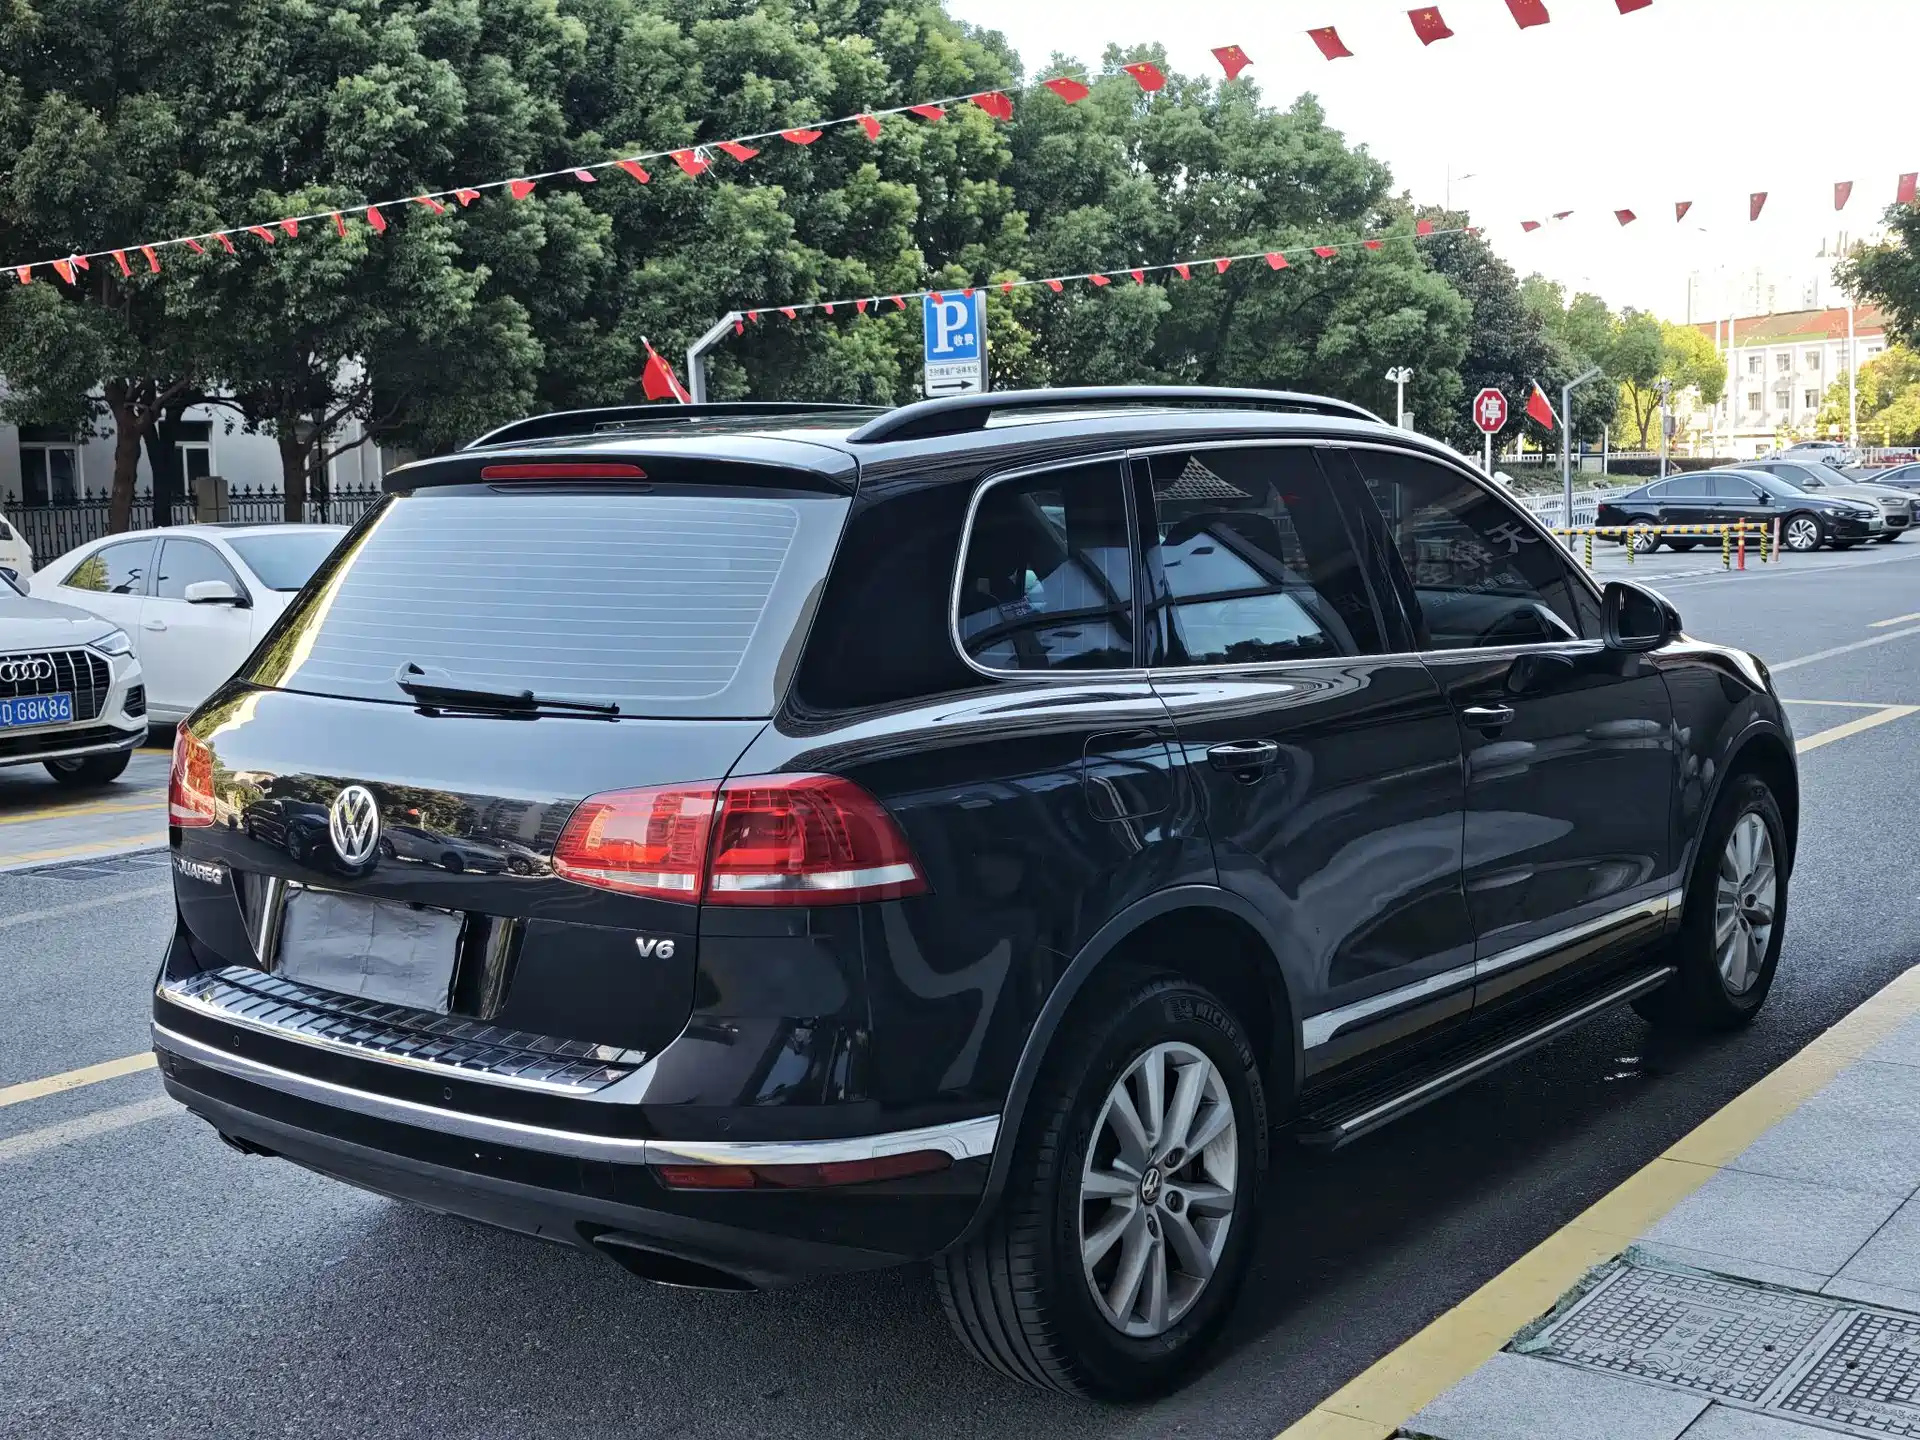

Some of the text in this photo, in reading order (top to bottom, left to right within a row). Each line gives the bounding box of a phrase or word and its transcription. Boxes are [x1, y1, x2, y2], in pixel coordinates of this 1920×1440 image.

[932, 301, 968, 353] P
[1480, 396, 1501, 425] 停
[635, 936, 675, 959] V6
[1195, 1002, 1252, 1066] MICHEIN
